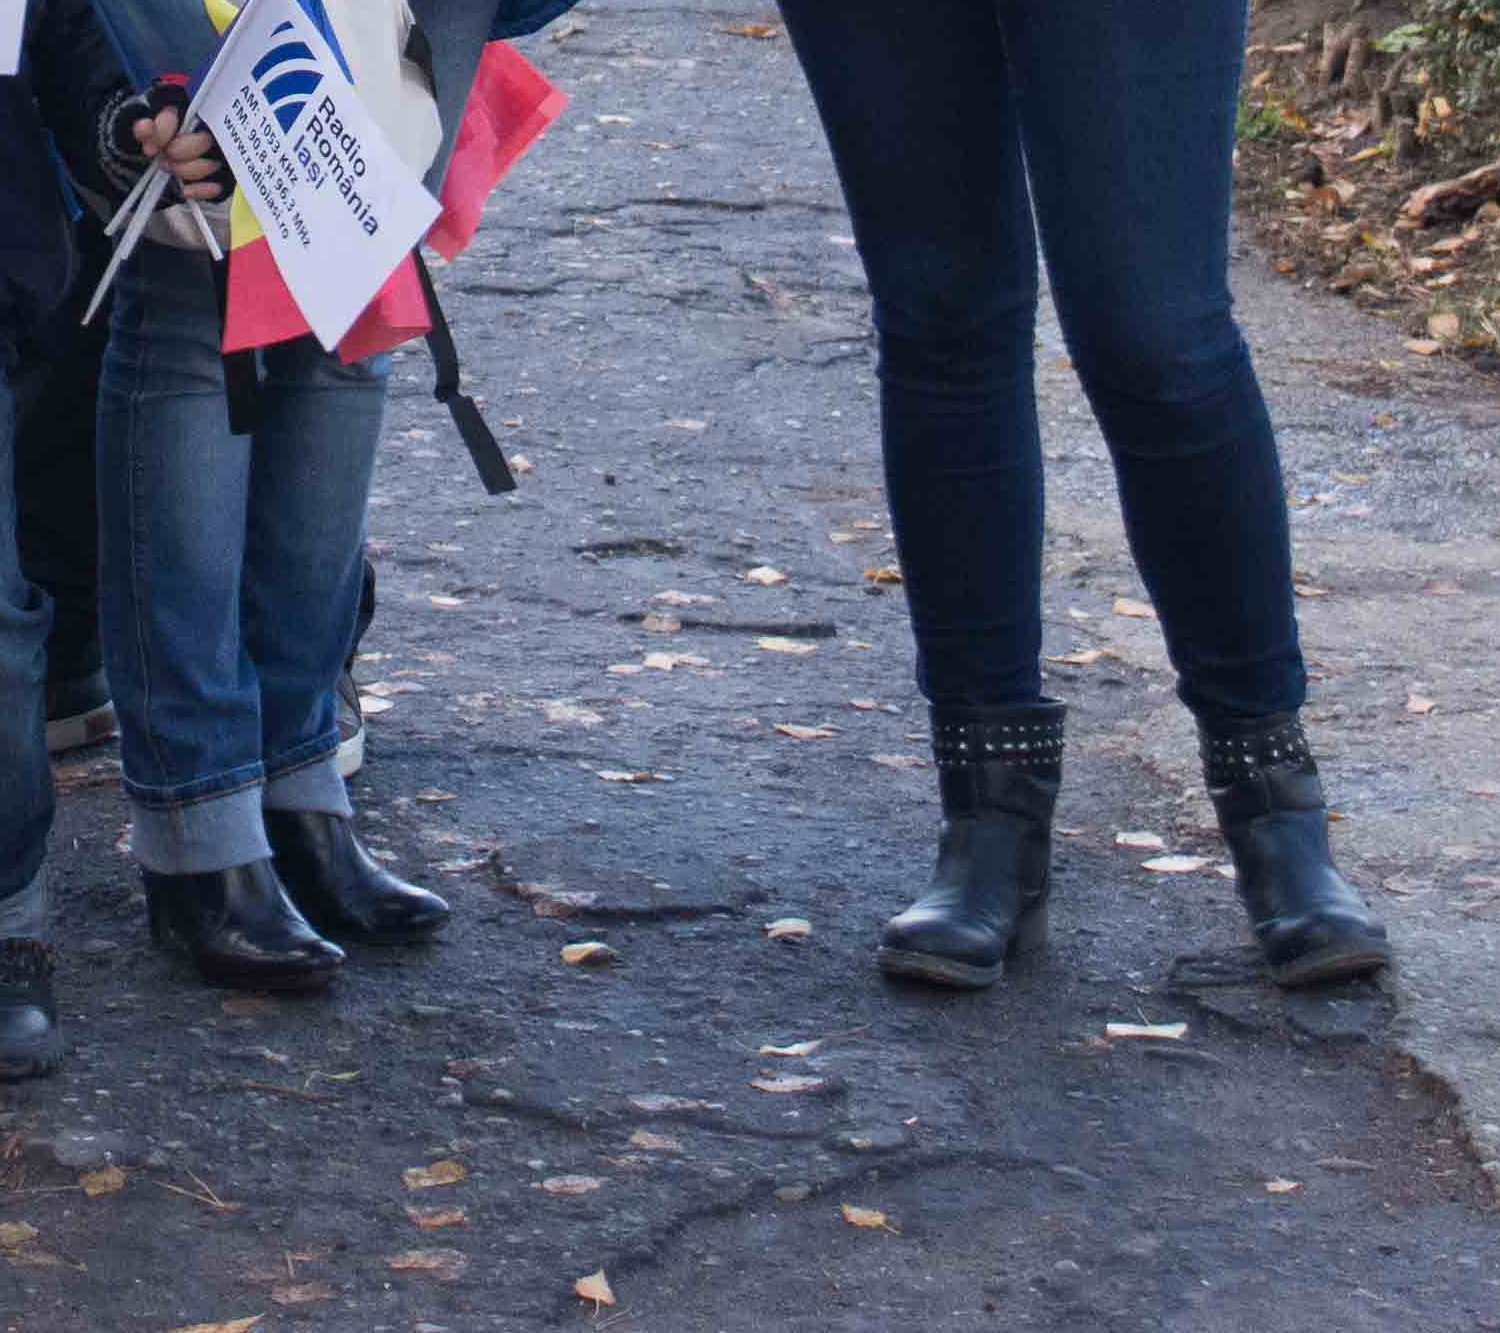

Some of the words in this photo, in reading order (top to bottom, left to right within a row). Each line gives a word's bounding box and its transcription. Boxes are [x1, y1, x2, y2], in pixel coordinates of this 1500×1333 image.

[223, 114, 290, 239] www.radioiasi.ro
[232, 99, 248, 130] FM:
[248, 129, 268, 164] 90,8
[274, 179, 296, 212] 96,3
[293, 212, 311, 248] MHz
[240, 85, 261, 114] AM:
[261, 116, 281, 154] 1053
[279, 154, 299, 185] KHz
[293, 135, 329, 190] Iași
[306, 115, 379, 237] România
[318, 95, 366, 177] Radio
